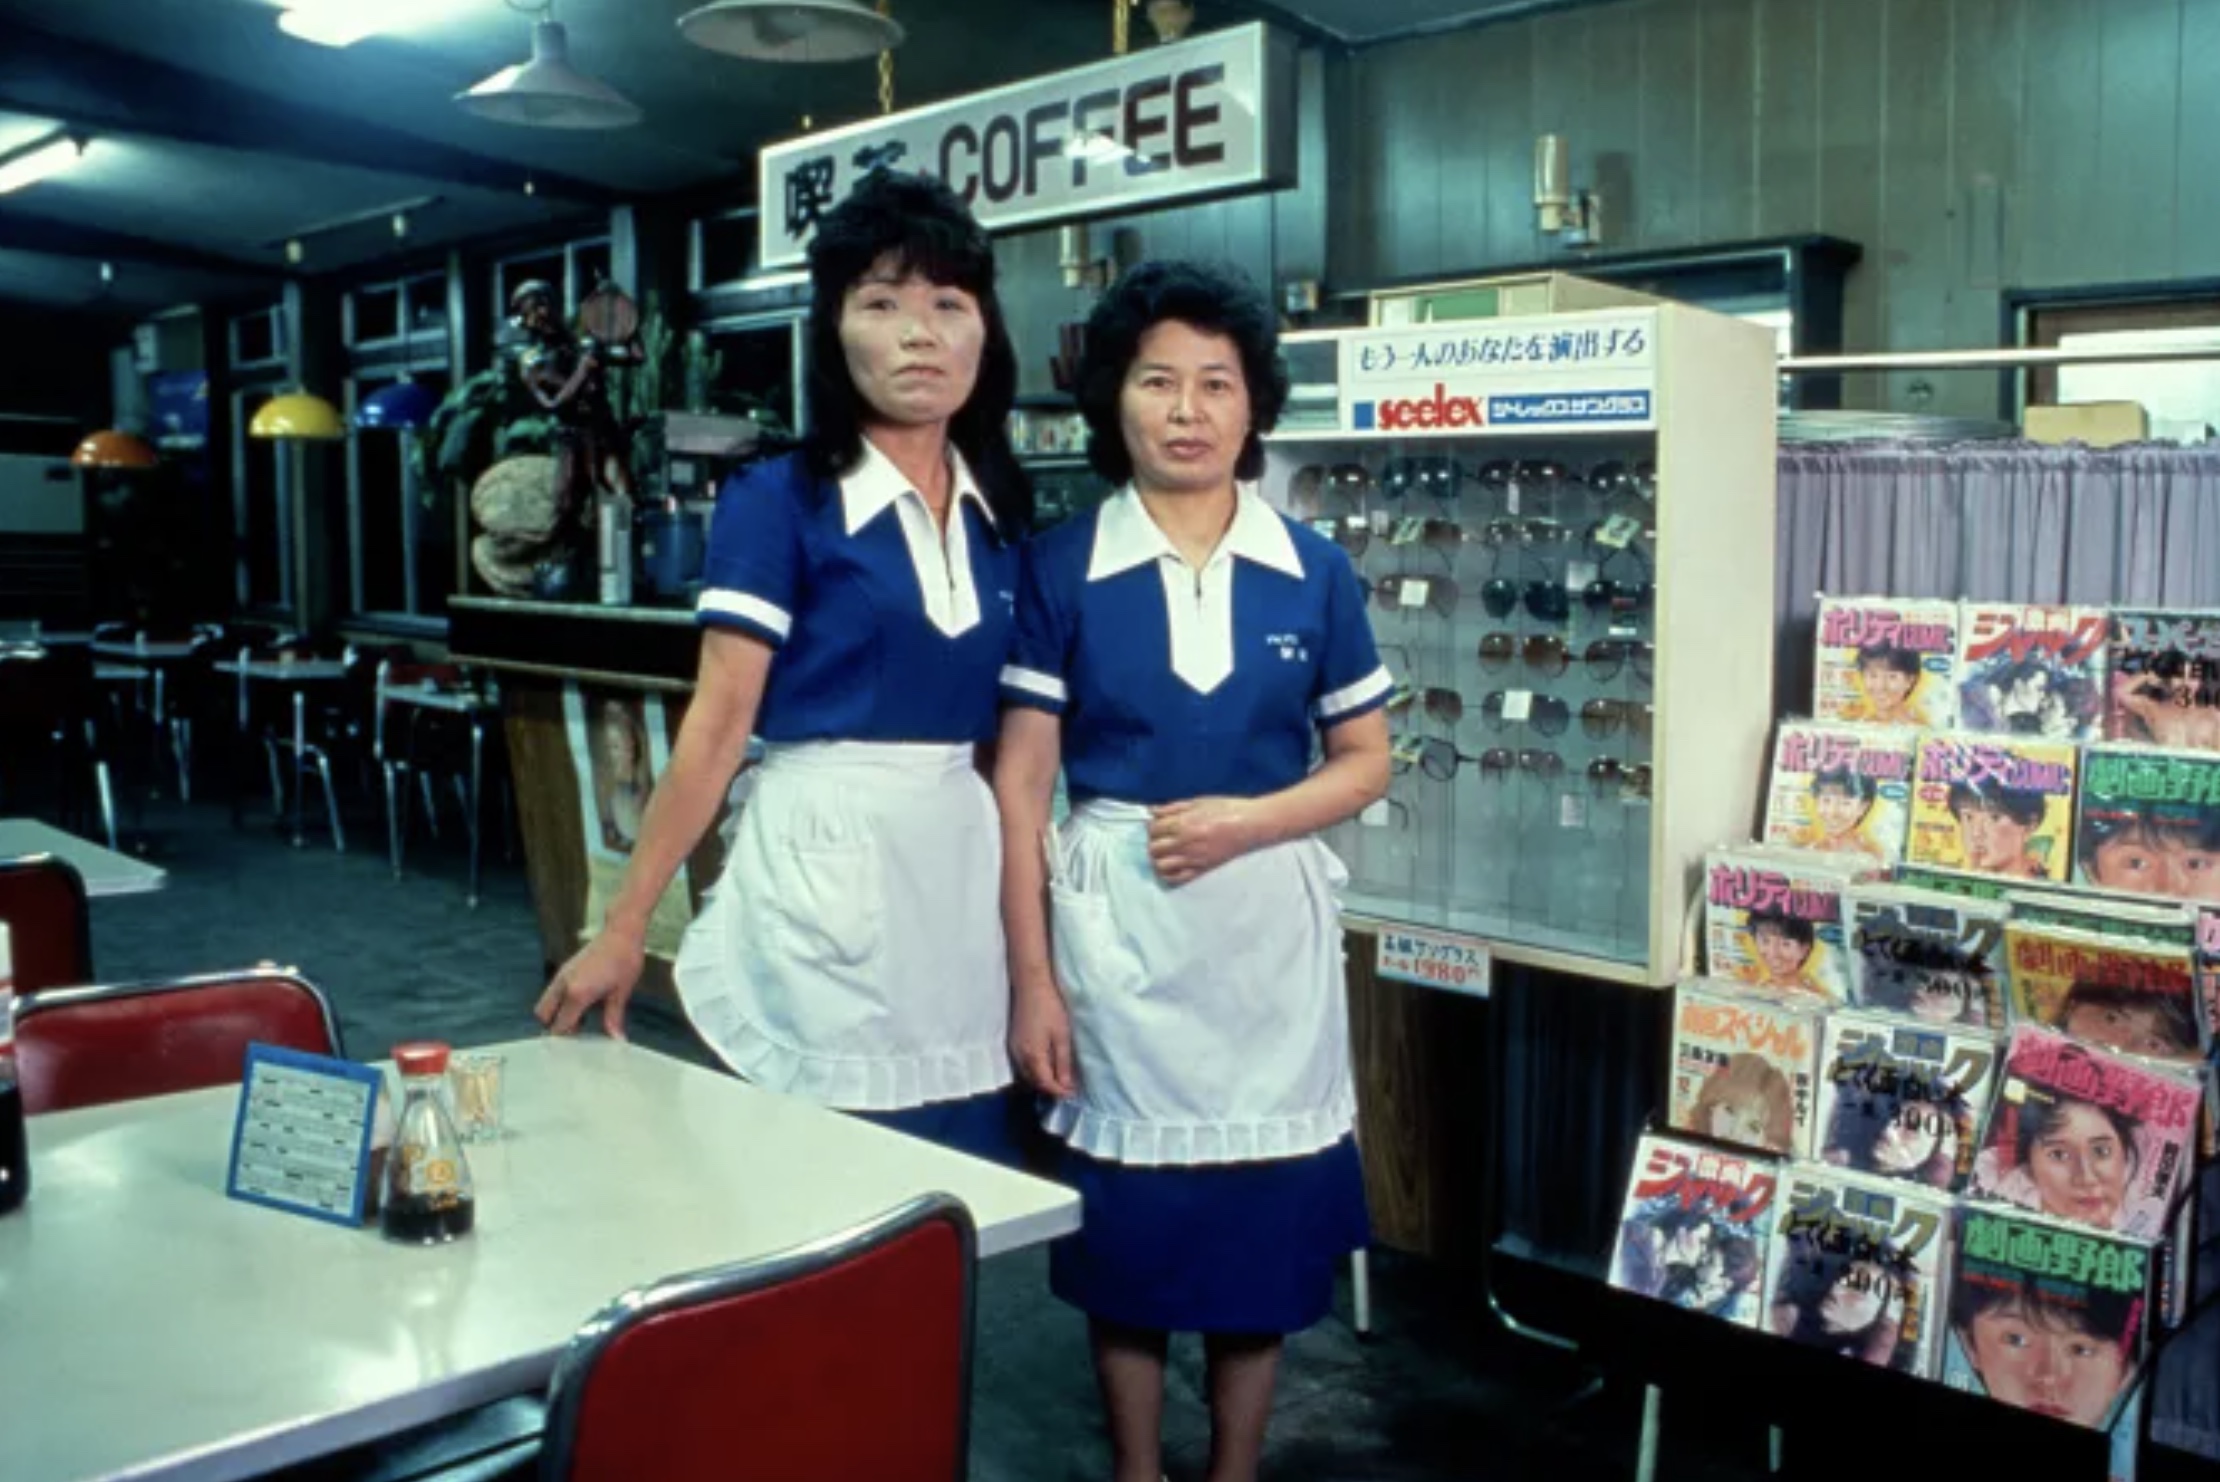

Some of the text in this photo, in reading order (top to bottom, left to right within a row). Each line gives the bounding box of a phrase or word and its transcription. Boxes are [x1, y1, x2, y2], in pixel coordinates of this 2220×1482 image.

[937, 62, 1226, 203] COFFEE
[1963, 1214, 2146, 1293] 劇画野郎
